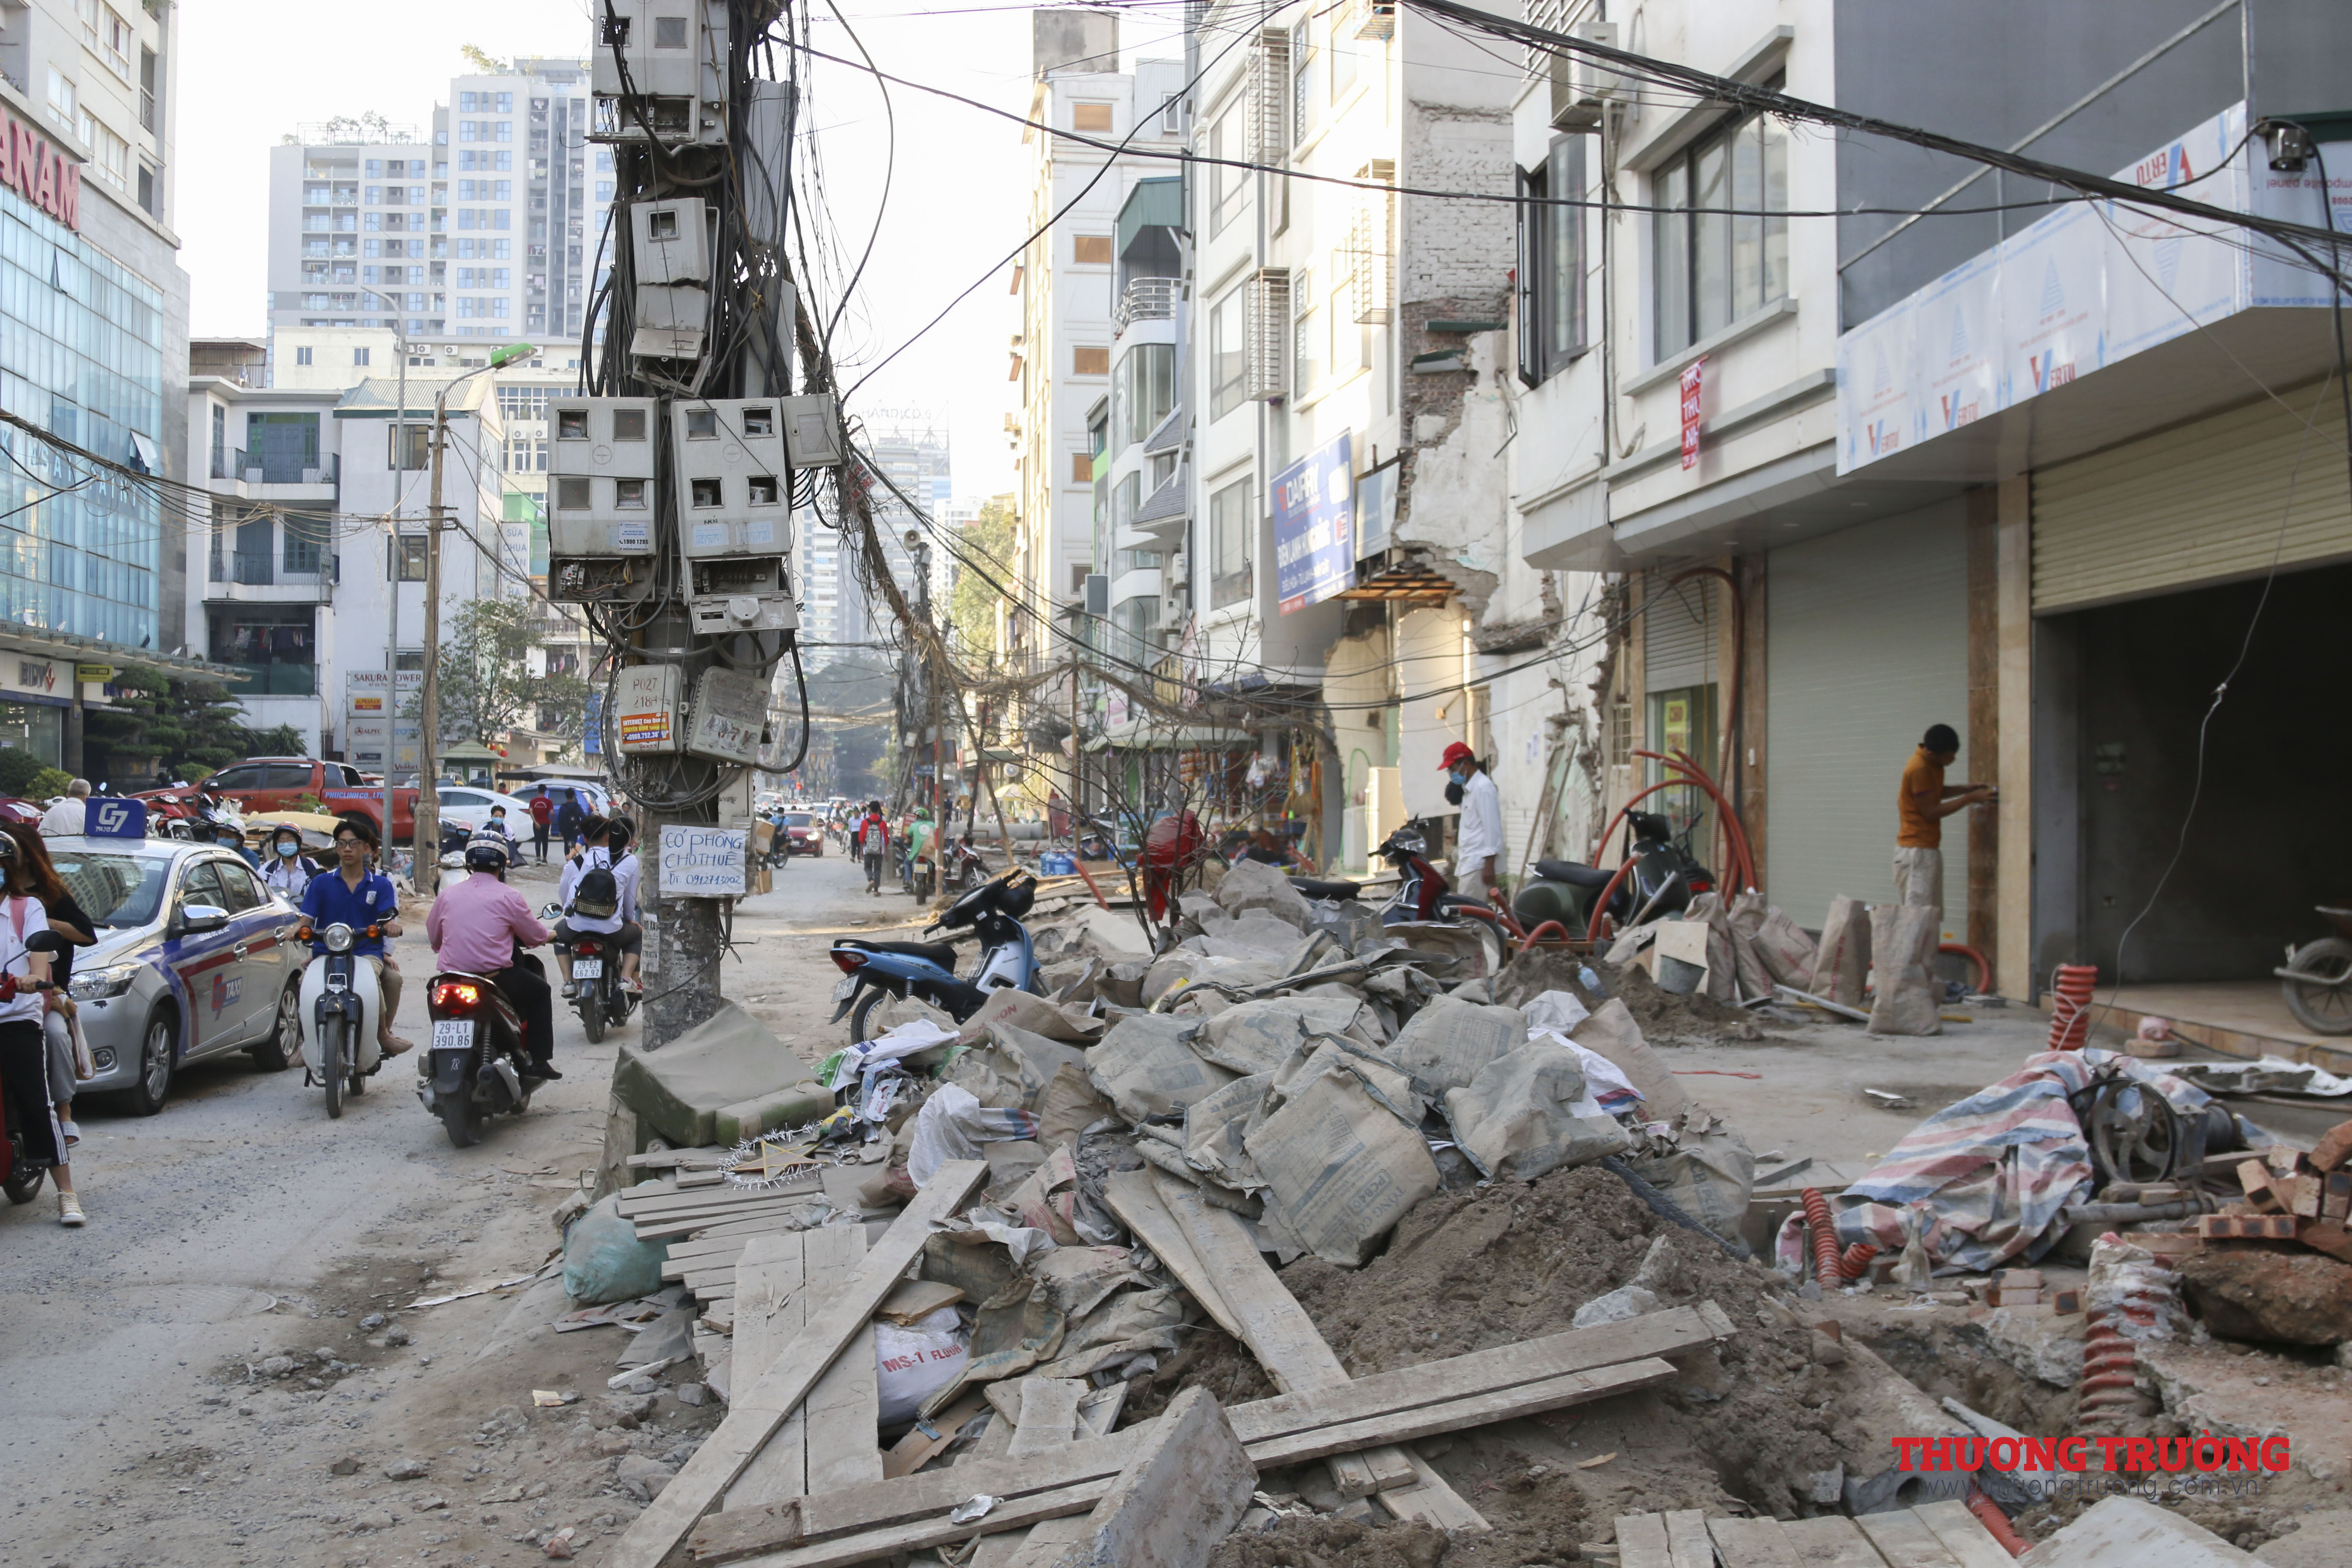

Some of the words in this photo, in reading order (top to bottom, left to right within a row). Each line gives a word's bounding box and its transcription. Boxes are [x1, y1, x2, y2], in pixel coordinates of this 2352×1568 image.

[2266, 178, 2300, 189] panel
[2030, 349, 2076, 394] VERTU
[862, 408, 921, 419] HANDICO
[1682, 396, 1700, 421] THU
[1941, 389, 1979, 430] VERTU
[1868, 420, 1900, 456] VERTU
[507, 527, 523, 537] SỮA
[19, 661, 46, 688] BIDV
[395, 674, 421, 682] OWER
[634, 678, 657, 692] P027
[98, 803, 129, 833] G7
[666, 829, 687, 848] CÓ
[690, 830, 743, 854] PHÒNG
[698, 851, 738, 866] THUÊ
[686, 874, 741, 885] 0912713002
[578, 961, 597, 969] 29-E2
[575, 969, 599, 977] 662.92
[226, 979, 242, 1000] TAXI
[439, 1023, 467, 1034] 29-L1
[435, 1035, 470, 1047] 390.86
[1352, 1175, 1387, 1209] PCB40
[882, 1351, 925, 1373] MS-1
[930, 1344, 962, 1360] FLOUR
